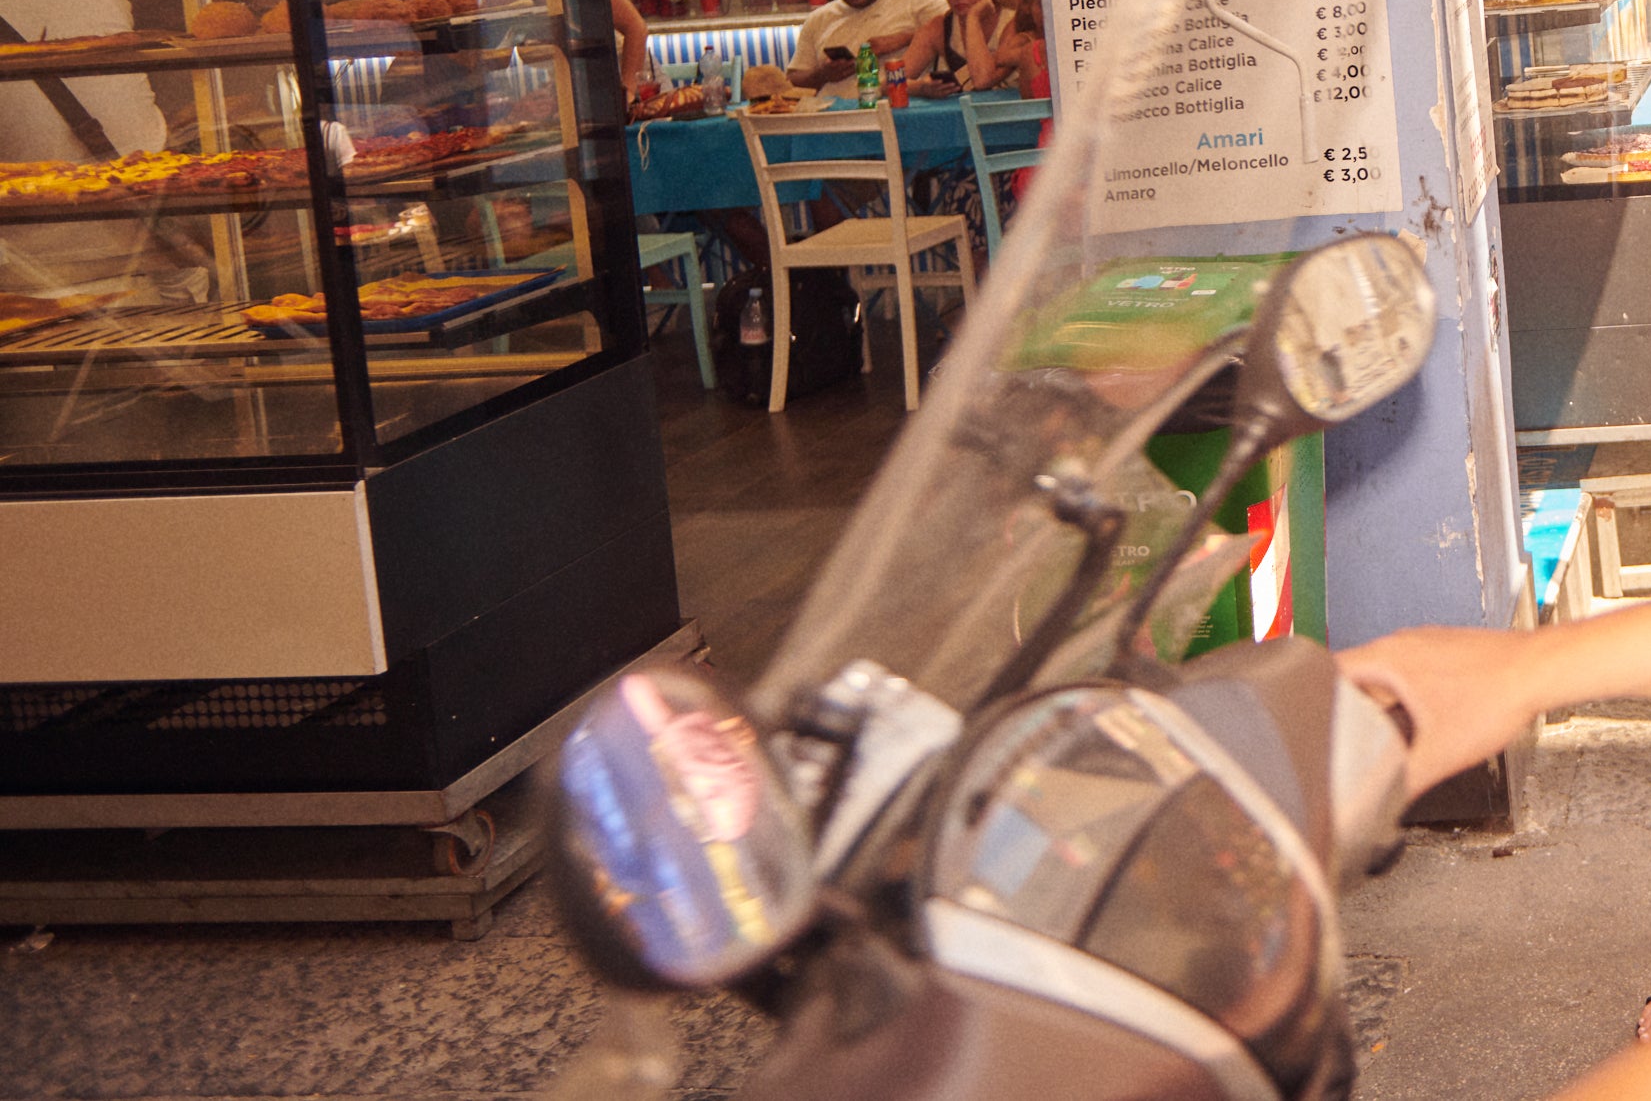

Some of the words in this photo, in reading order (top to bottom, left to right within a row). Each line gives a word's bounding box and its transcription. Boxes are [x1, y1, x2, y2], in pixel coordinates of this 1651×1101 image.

[1316, 7, 1327, 19] €
[1188, 35, 1235, 51] Calice
[1317, 28, 1327, 40] €
[1188, 53, 1257, 72] Bottiglia
[1317, 48, 1328, 60] €
[1175, 79, 1222, 95] Calice
[1175, 97, 1245, 115] Bottiglia
[1197, 128, 1263, 150] Amari
[1324, 148, 1335, 161] €
[1104, 187, 1156, 202] Amaro
[1323, 169, 1335, 182] €
[1107, 300, 1176, 309] VETRO
